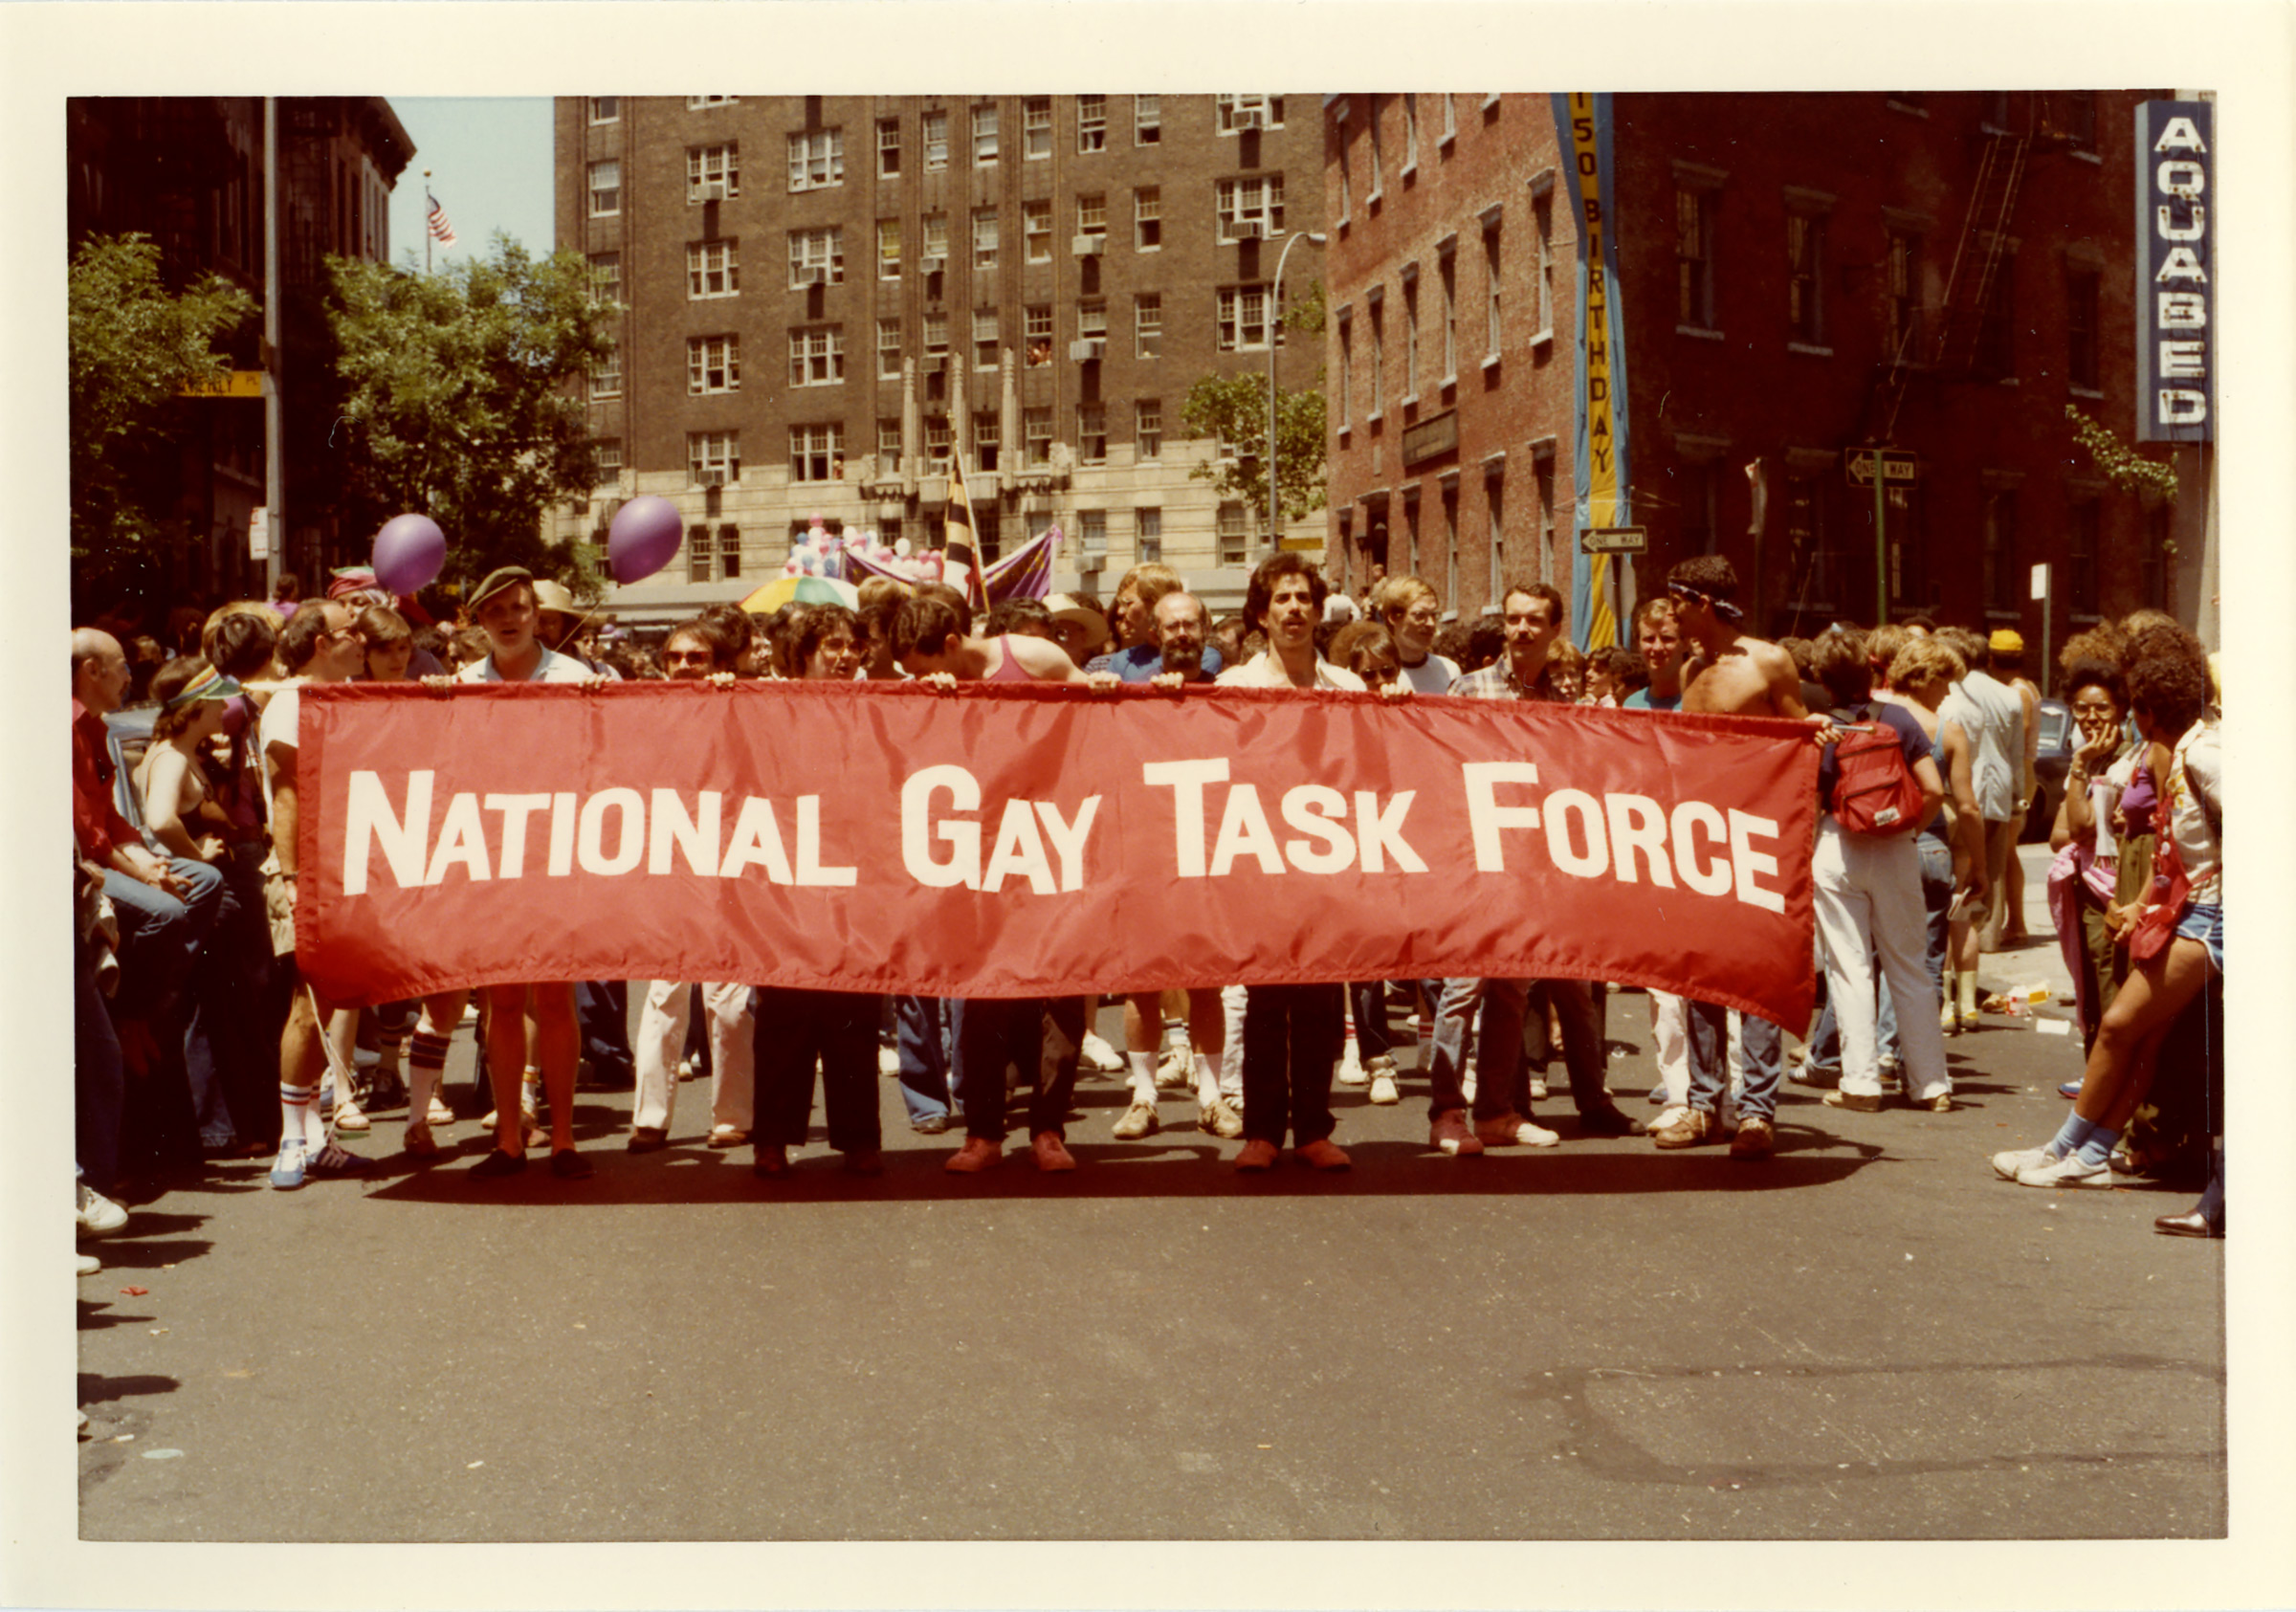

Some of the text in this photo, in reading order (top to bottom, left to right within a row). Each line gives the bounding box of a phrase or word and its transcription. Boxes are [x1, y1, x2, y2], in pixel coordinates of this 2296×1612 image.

[1583, 198, 1609, 474] BIRTHDAY
[2153, 117, 2208, 425] AQUABED
[1588, 534, 1641, 547] ONE WAY
[1855, 460, 1911, 476] ONE WAY
[342, 757, 1785, 915] NATIONAL GAY TASK FORCE
